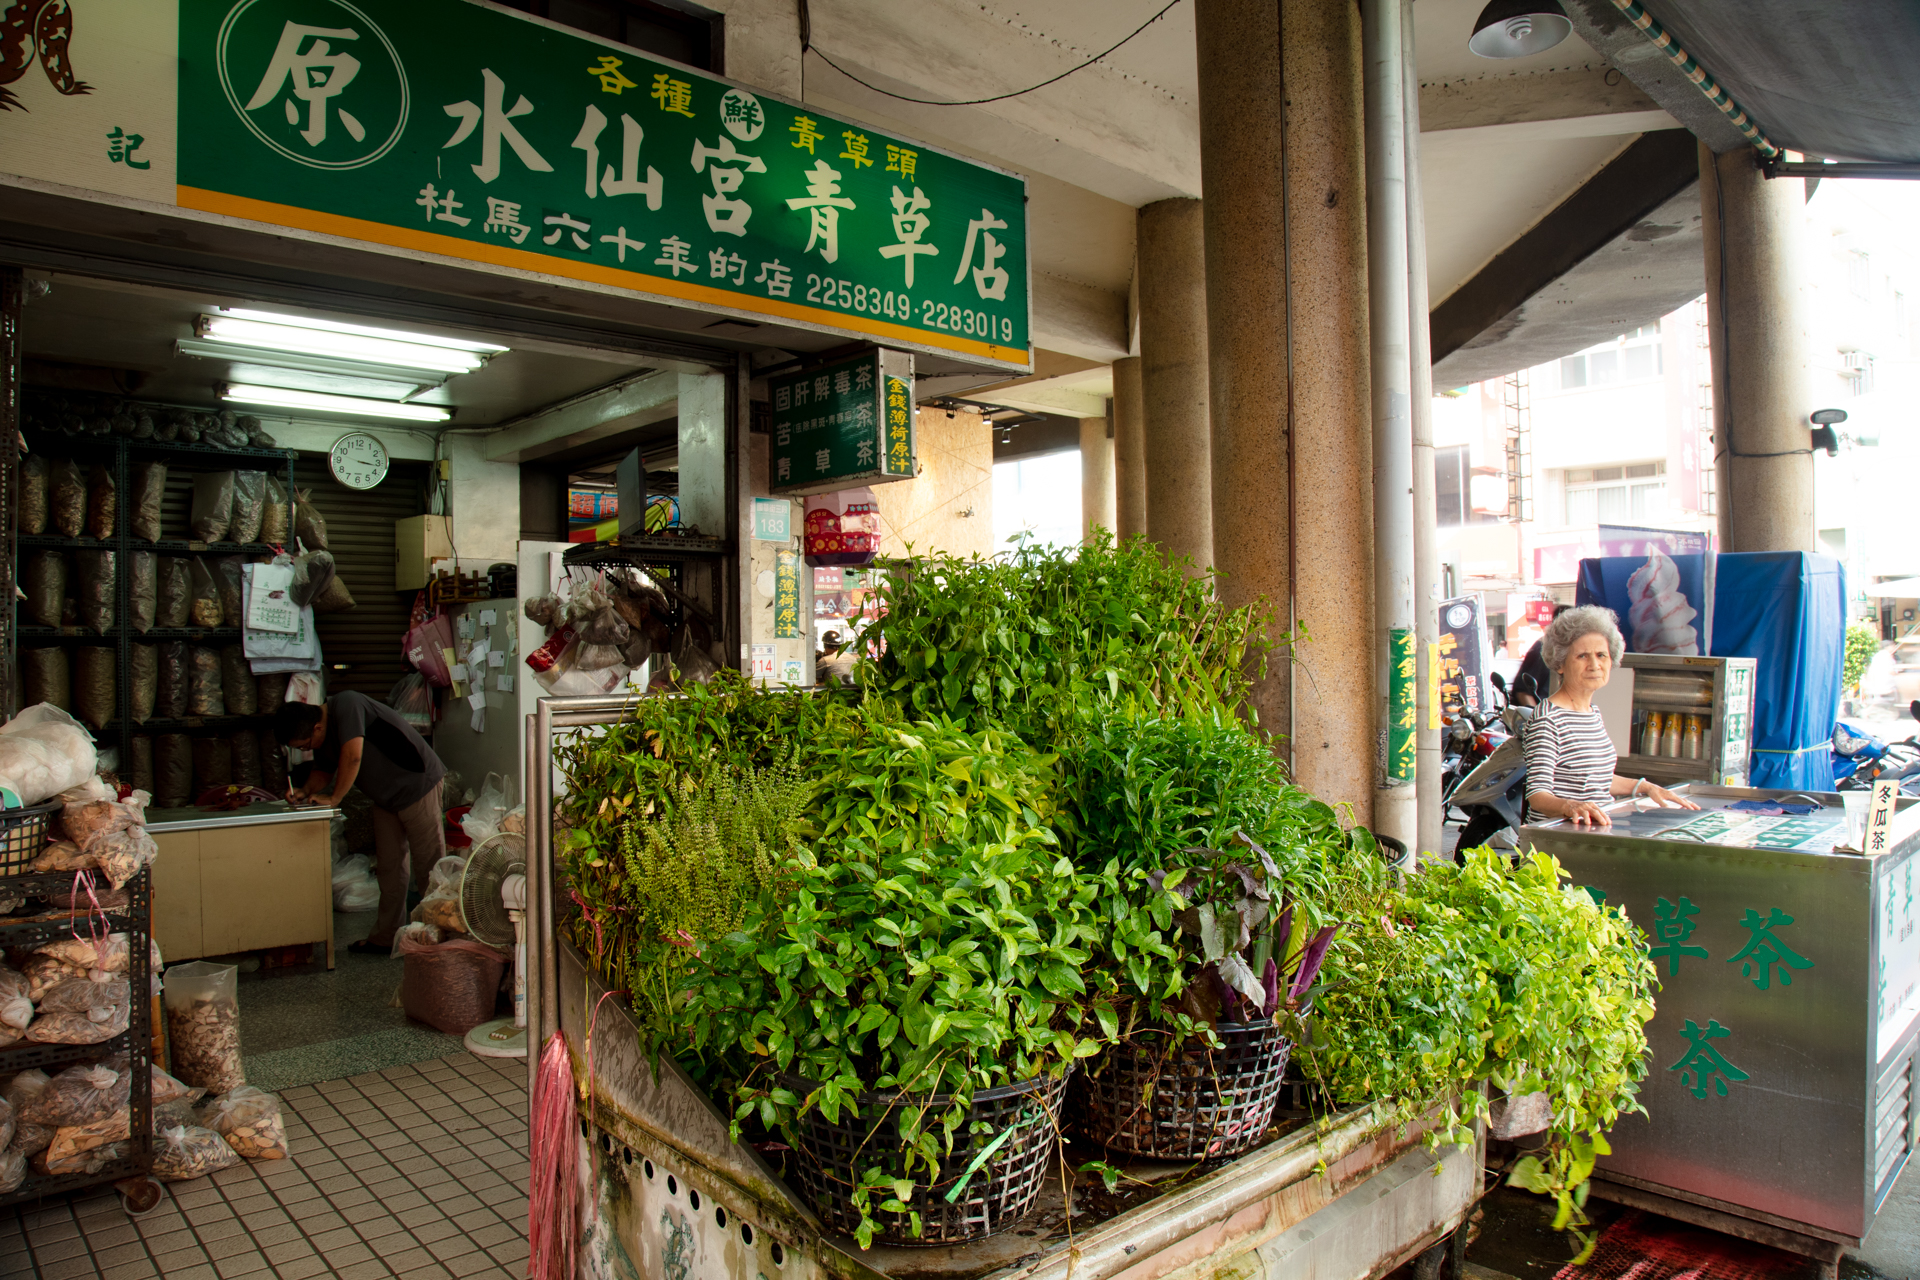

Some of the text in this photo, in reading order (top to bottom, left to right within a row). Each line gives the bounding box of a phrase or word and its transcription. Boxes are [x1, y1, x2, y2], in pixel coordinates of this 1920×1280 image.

[244, 20, 366, 147] 原
[106, 126, 150, 170] 記
[442, 67, 1010, 302] 水仙宮青草店
[775, 364, 873, 412] 固肝解毒茶
[347, 441, 354, 449] 11
[356, 439, 364, 447] 12
[887, 378, 910, 473] 金錢薄荷原汁
[336, 456, 342, 464] 9
[340, 447, 348, 455] 10
[375, 459, 381, 467] 3
[776, 439, 874, 482] 青草茶
[346, 472, 351, 480] 7
[365, 474, 371, 482] 5
[761, 518, 784, 534] 183
[777, 549, 798, 637] 金錢薄荷原汁
[1871, 784, 1892, 851] 冬瓜茶
[1667, 1018, 1751, 1100] 茶
